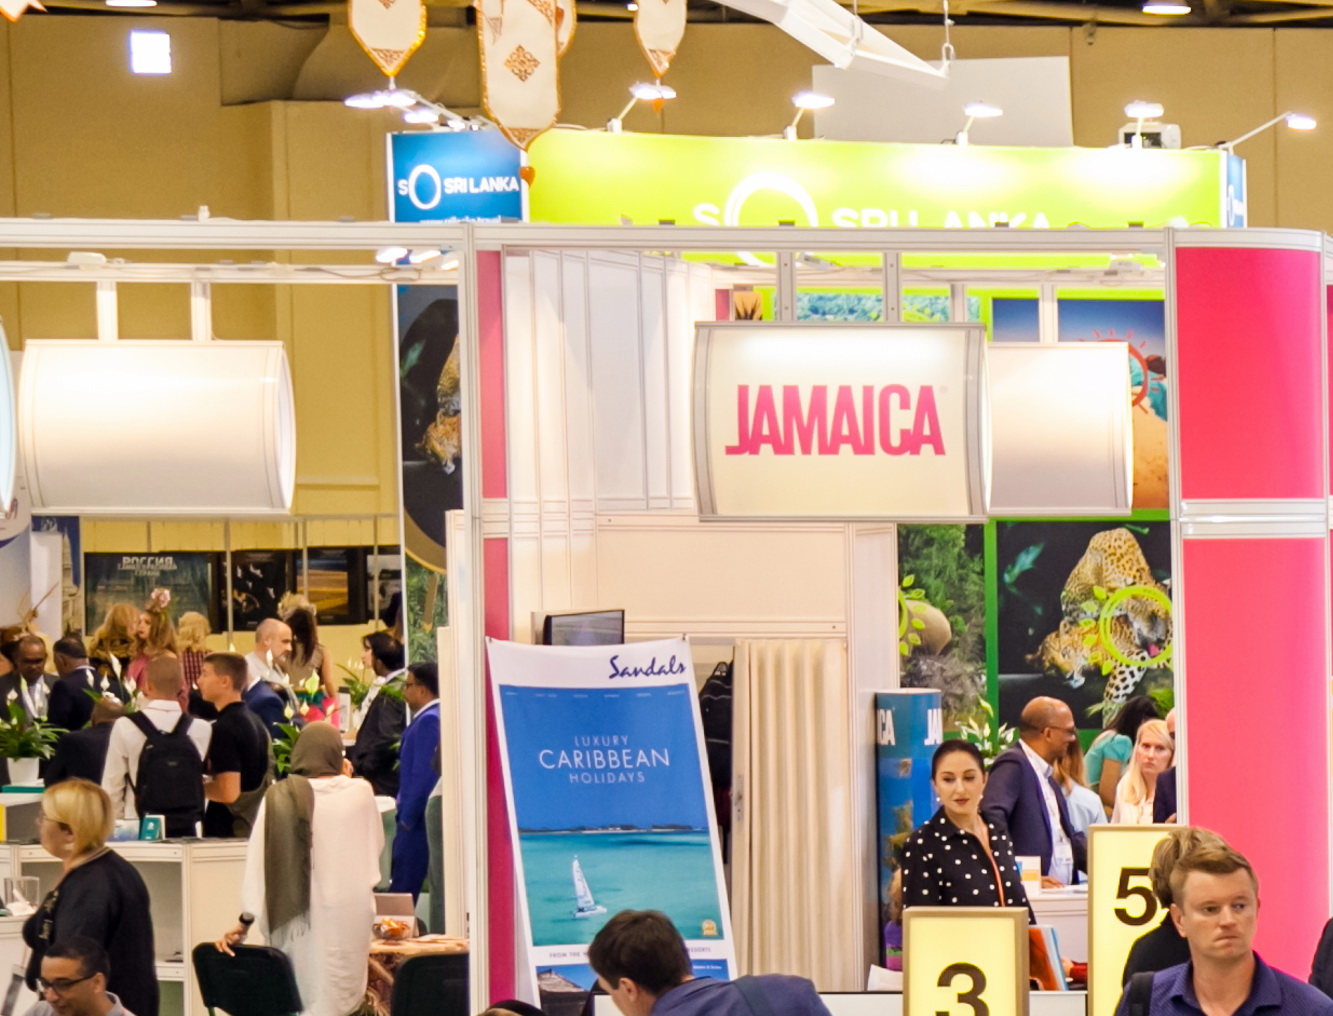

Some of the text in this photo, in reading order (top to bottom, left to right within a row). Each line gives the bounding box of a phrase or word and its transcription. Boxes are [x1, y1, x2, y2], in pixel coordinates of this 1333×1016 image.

[444, 178, 467, 194] SRI
[469, 177, 520, 193] LANKA
[725, 383, 946, 456] JAMAICA
[608, 654, 686, 679] Sandals
[574, 735, 629, 747] LUXURY
[538, 748, 671, 770] CARIBBEAN
[569, 771, 645, 784] HOLIDAYS
[1113, 867, 1161, 926] 5
